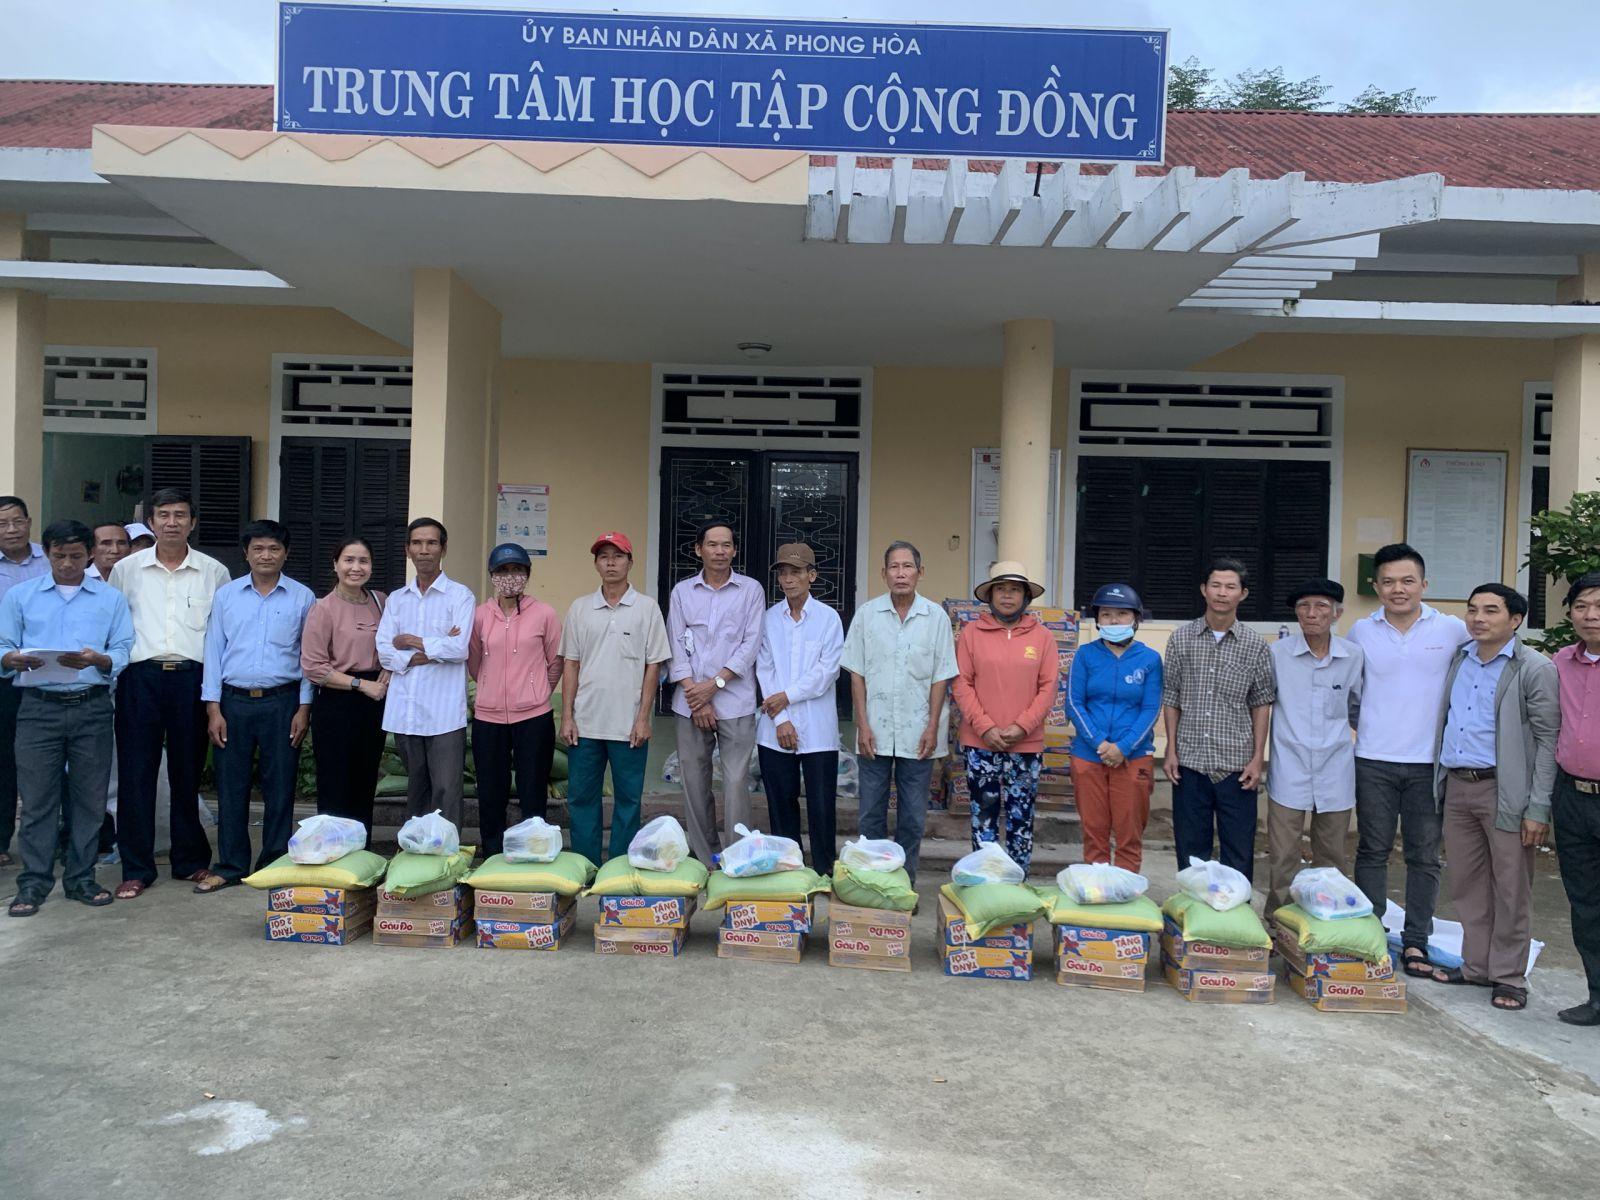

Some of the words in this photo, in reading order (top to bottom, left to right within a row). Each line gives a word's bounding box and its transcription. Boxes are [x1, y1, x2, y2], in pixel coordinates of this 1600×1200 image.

[522, 19, 552, 44] ỦY
[562, 26, 609, 46] BAN
[616, 26, 682, 49] NHÂN
[690, 28, 738, 51] DÂN
[745, 30, 777, 51] XÃ
[785, 34, 865, 54] PHONG
[872, 33, 921, 56] HÒA
[303, 66, 474, 119] TRUNG
[489, 60, 596, 122] TÂM
[609, 77, 715, 138] HỌC
[731, 68, 828, 142] TẬP
[843, 72, 982, 146] CỘNG
[996, 64, 1138, 142] ĐỒNG
